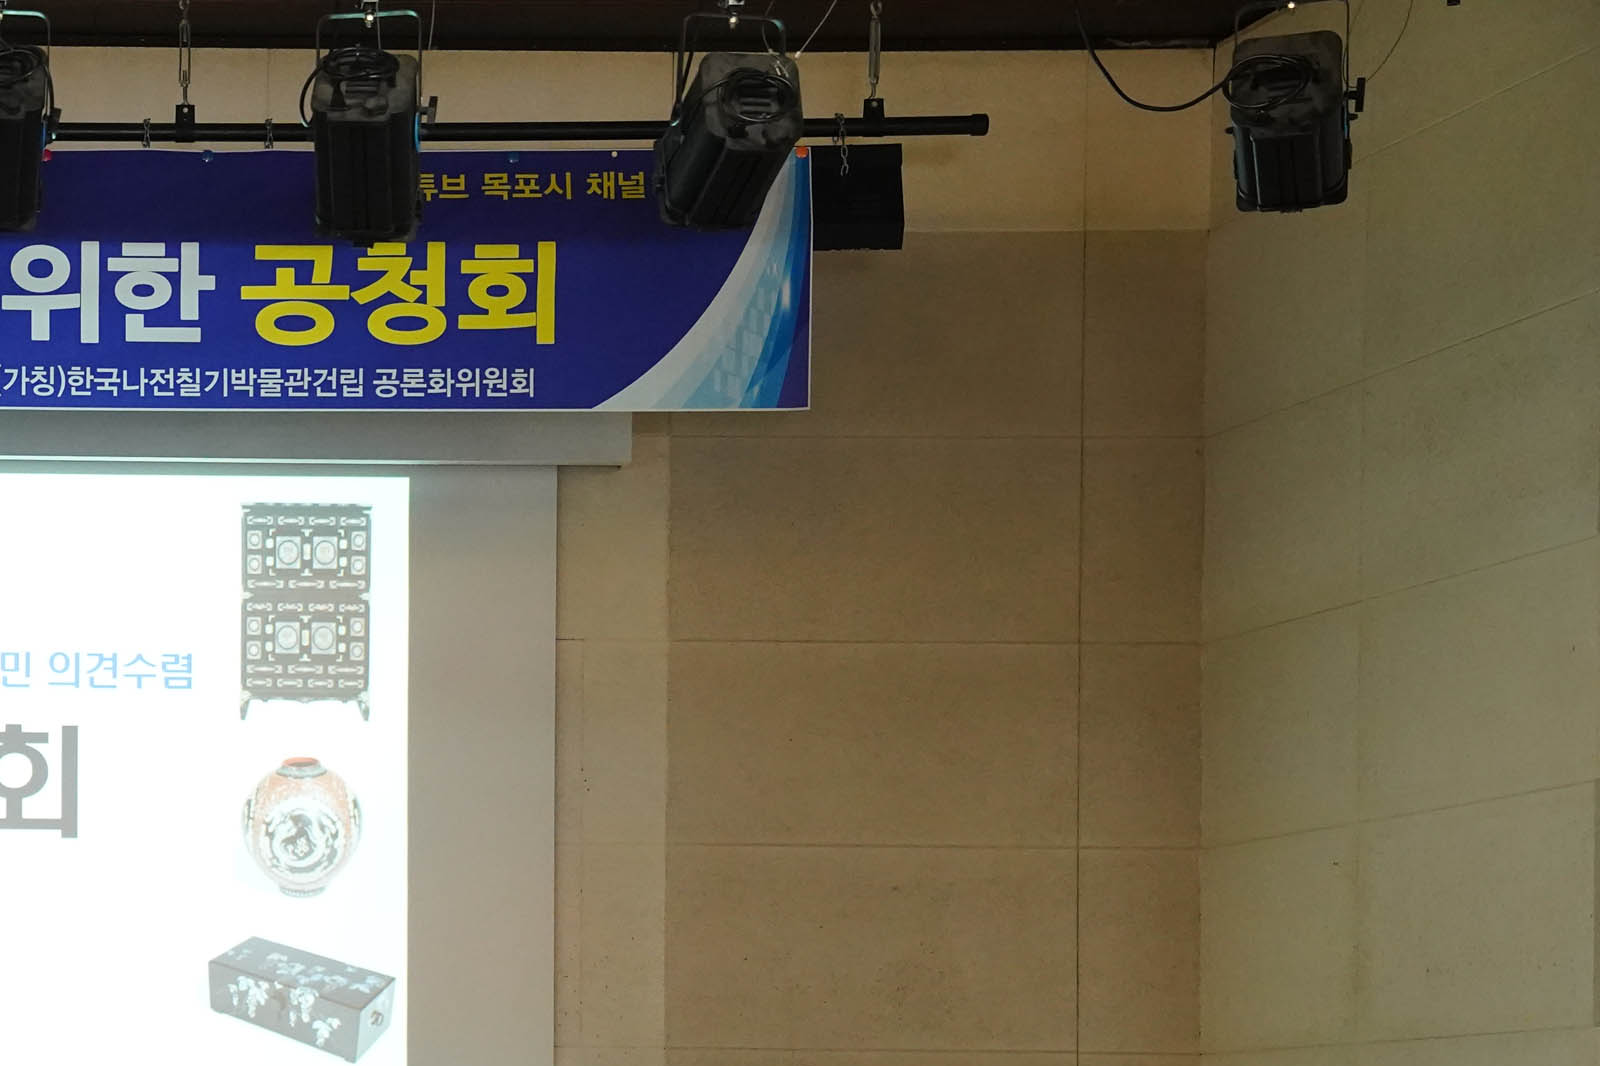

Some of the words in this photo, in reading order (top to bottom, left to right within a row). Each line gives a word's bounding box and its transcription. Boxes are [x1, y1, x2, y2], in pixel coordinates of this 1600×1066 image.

[481, 171, 572, 201] 목포시
[586, 171, 646, 200] 채널
[1, 240, 216, 344] 위한
[240, 241, 557, 346] 공청회
[371, 366, 535, 398] 공론화위원회
[47, 651, 194, 690] 의견수렴
